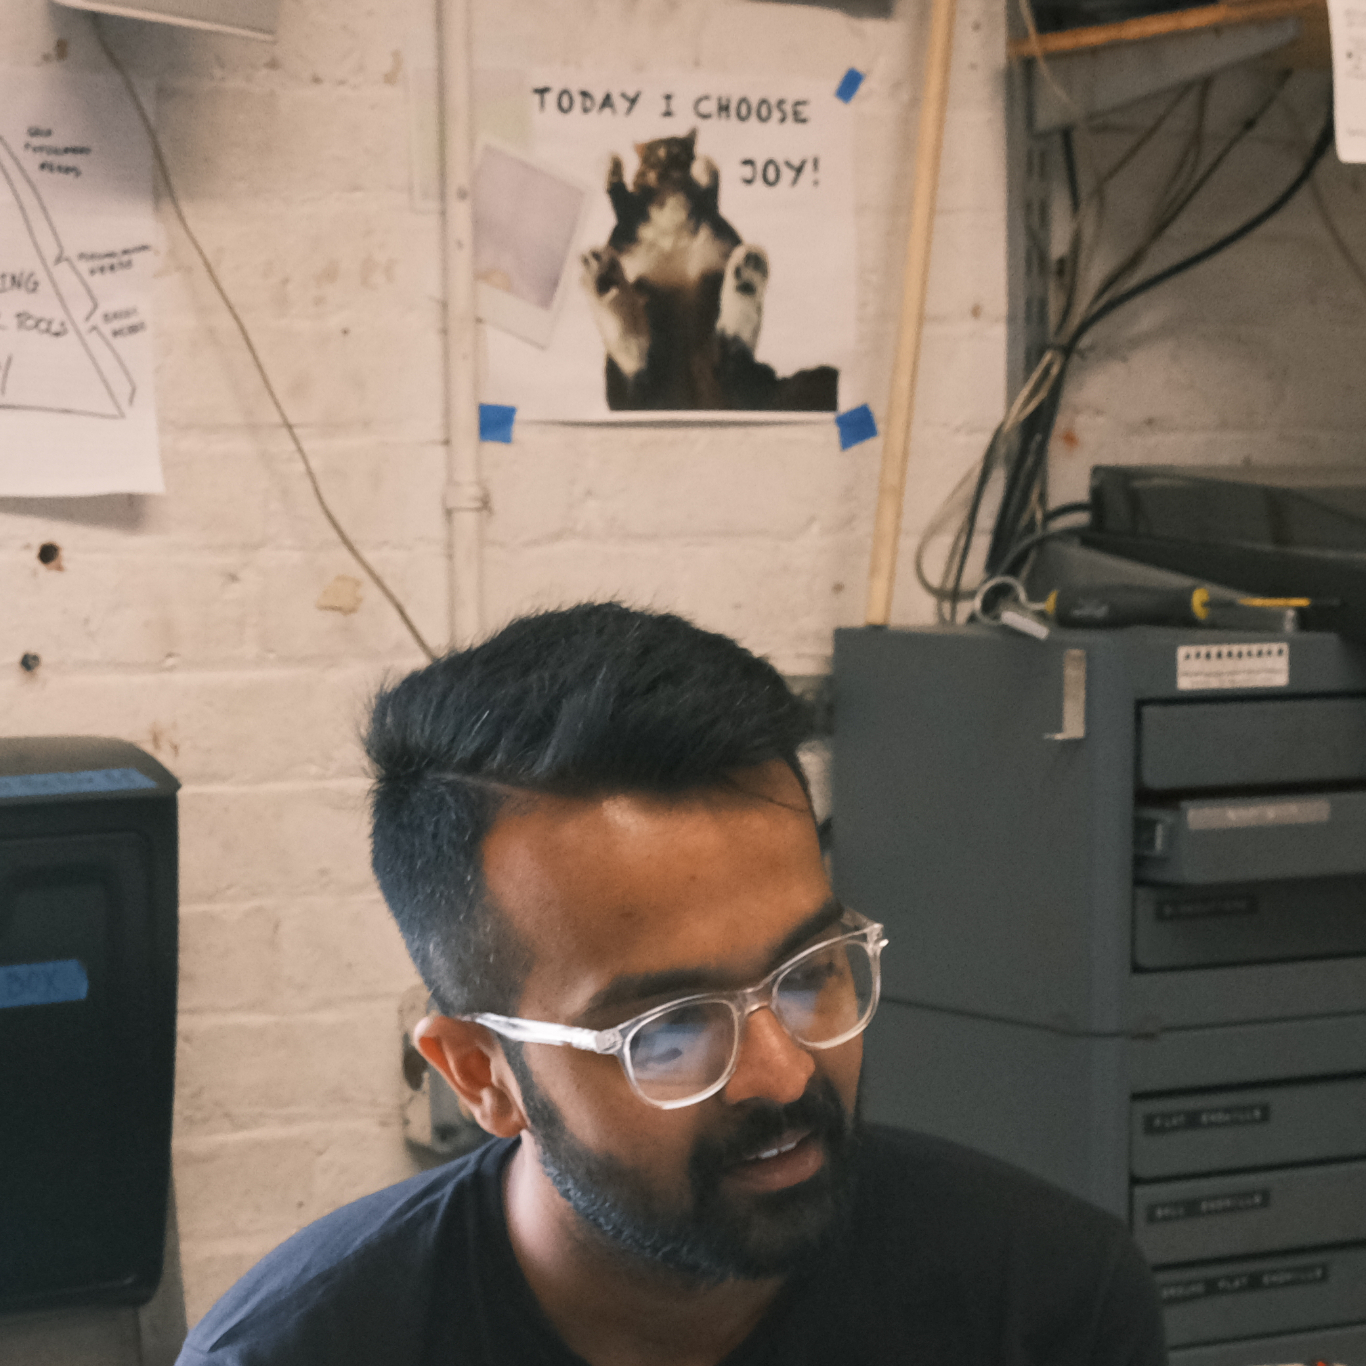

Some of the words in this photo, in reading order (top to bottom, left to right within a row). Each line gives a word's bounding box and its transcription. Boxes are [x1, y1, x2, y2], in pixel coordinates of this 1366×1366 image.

[532, 86, 642, 115] TODAY
[661, 93, 675, 117] I
[693, 94, 811, 124] CHOOSE
[740, 156, 822, 188] JOY!
